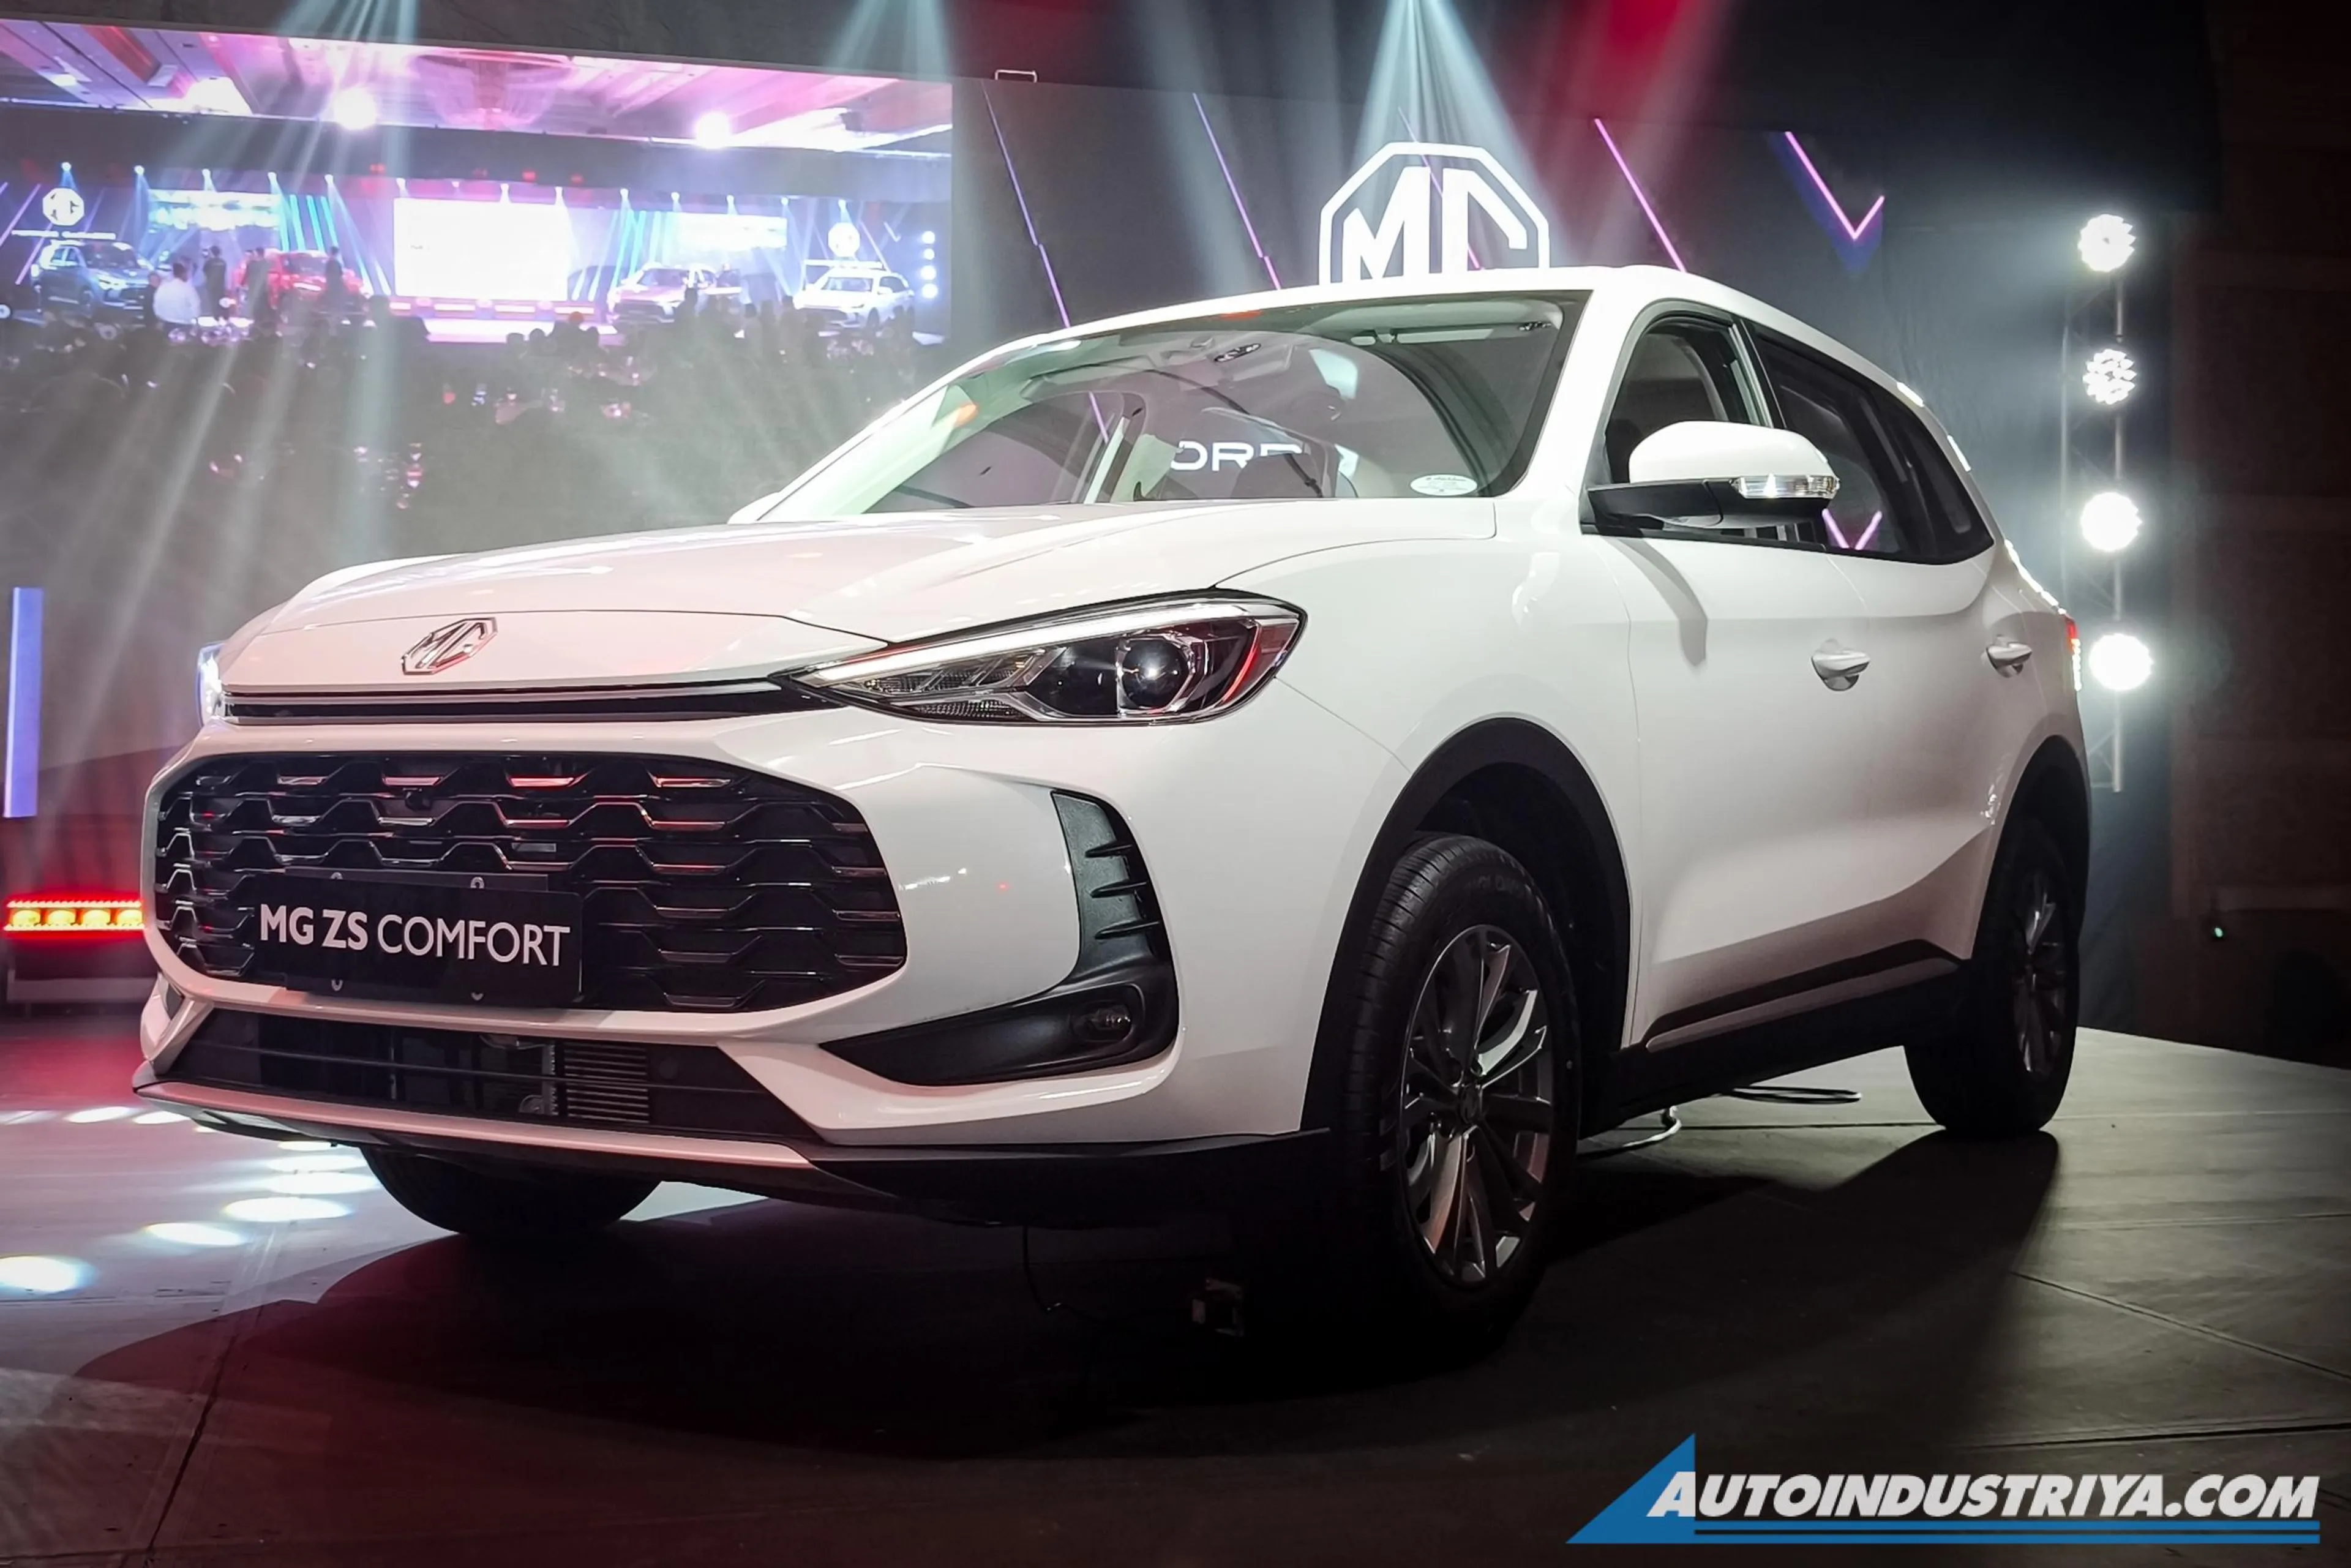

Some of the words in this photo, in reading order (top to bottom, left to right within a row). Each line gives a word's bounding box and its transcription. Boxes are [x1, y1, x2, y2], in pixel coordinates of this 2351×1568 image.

[407, 621, 490, 670] MG
[260, 904, 314, 946] MG
[321, 909, 368, 951] ZS
[377, 914, 571, 966] COMFORT
